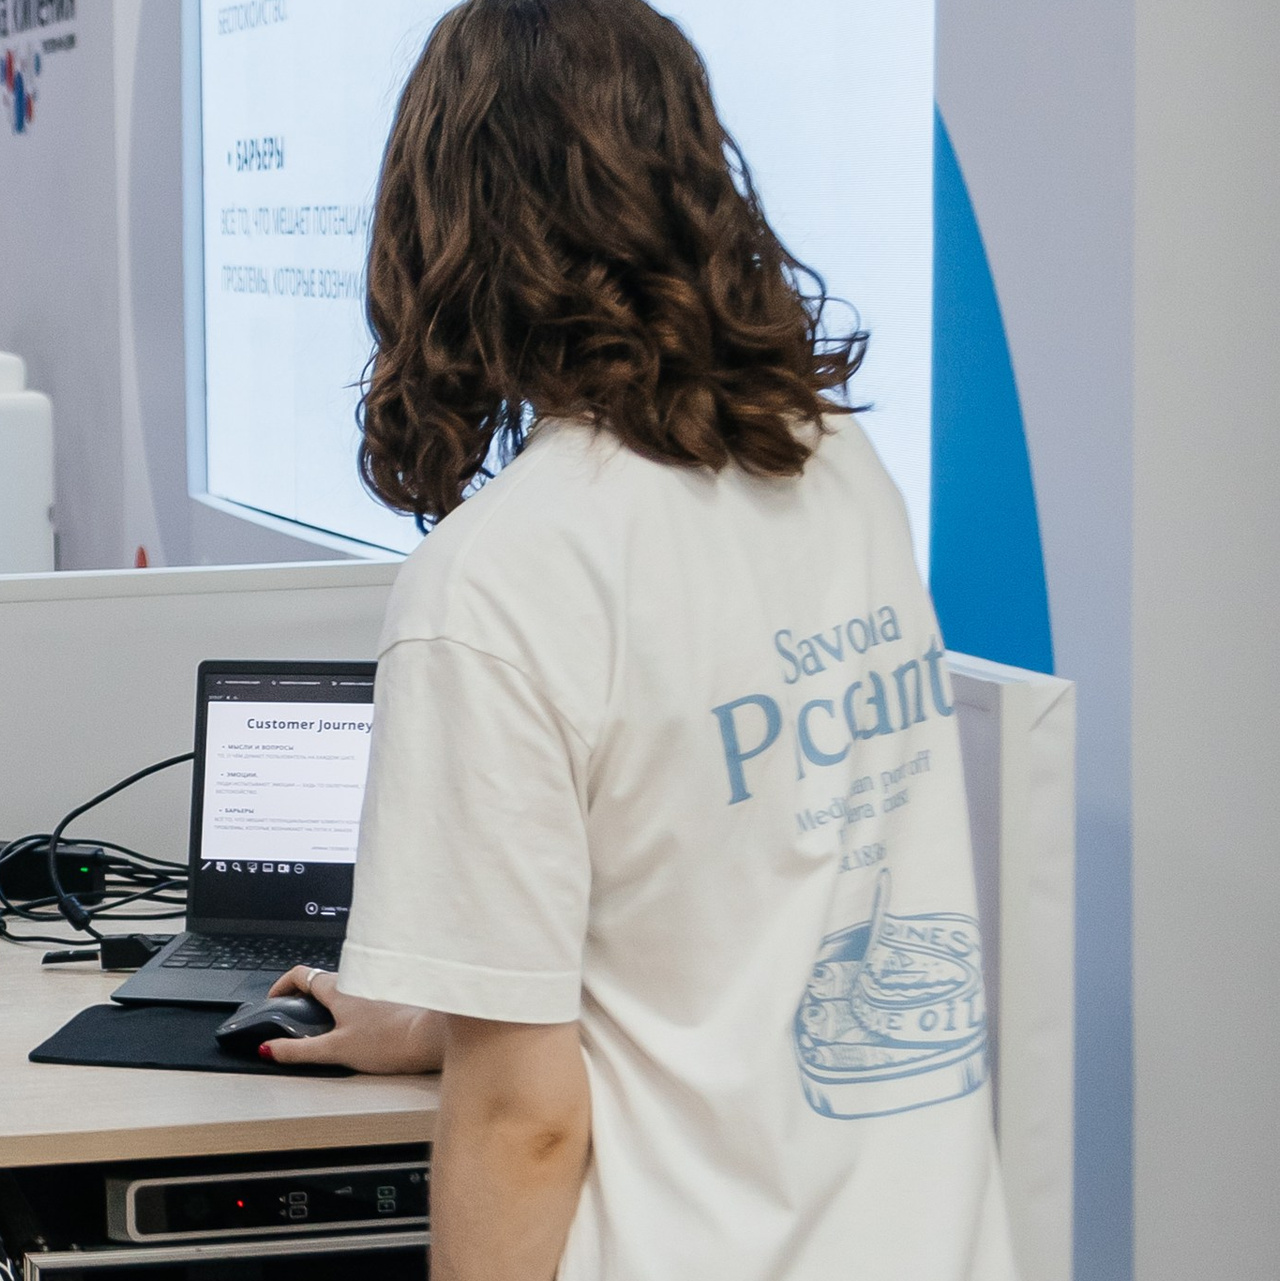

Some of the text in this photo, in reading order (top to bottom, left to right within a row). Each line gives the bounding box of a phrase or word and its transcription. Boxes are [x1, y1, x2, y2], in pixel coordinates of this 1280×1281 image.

[235, 135, 285, 172] БАРЬЕРЫ
[246, 717, 373, 734] Customer Journey
